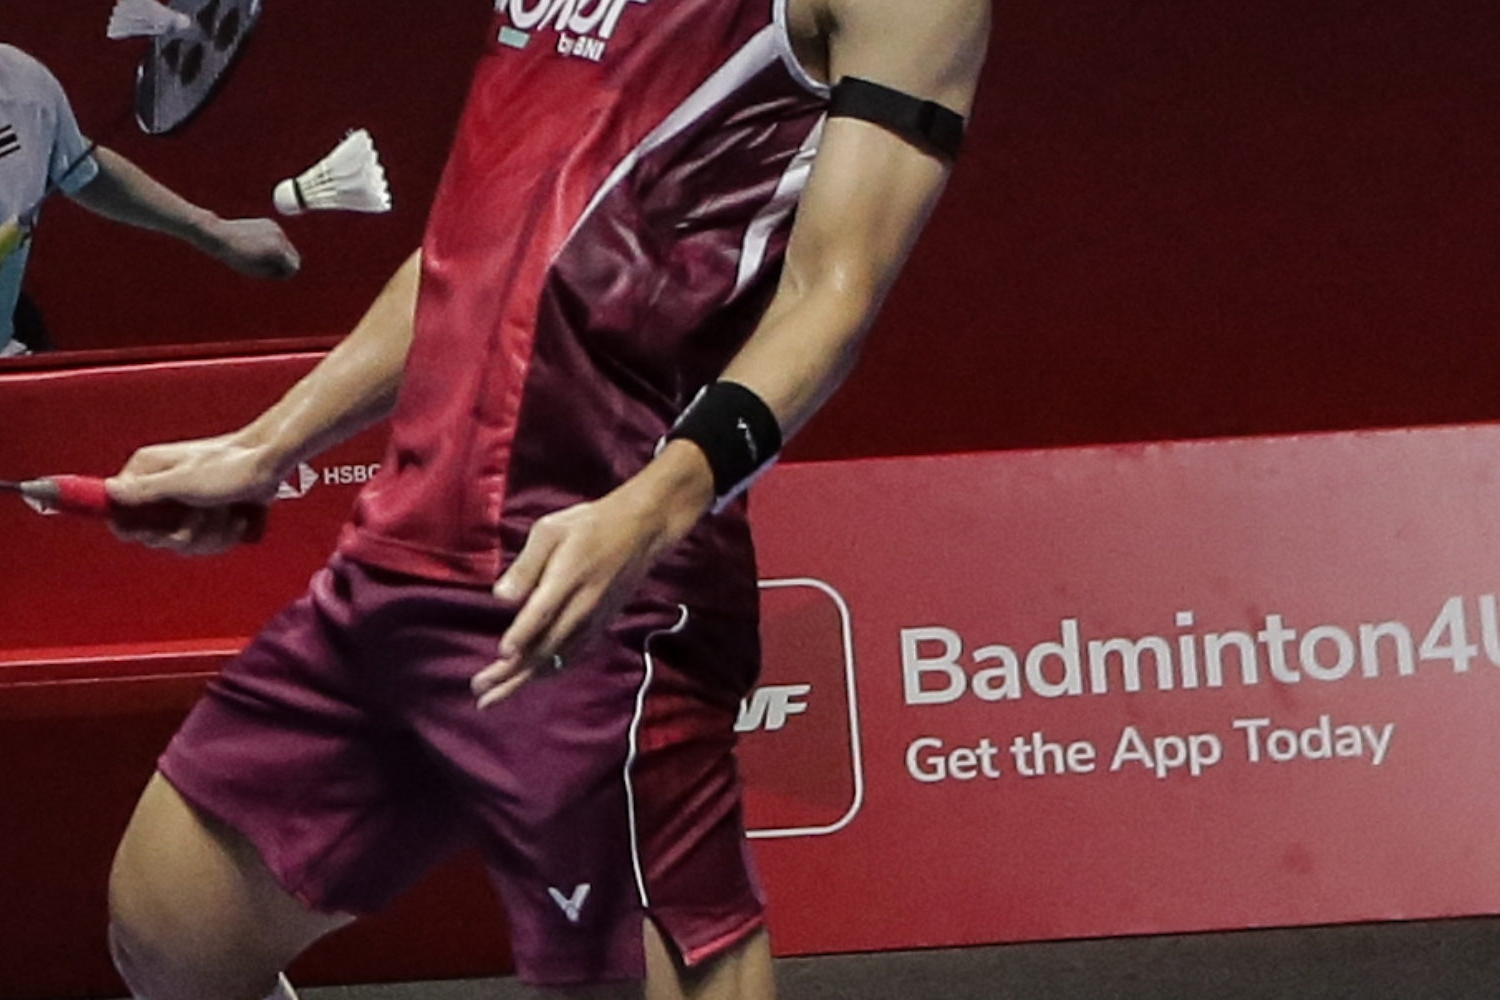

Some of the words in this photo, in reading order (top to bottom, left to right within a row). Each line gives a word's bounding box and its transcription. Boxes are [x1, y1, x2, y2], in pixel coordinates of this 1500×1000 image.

[906, 738, 1000, 782] Get
[1010, 732, 1096, 777] the
[1111, 726, 1222, 777] App
[1233, 715, 1395, 765] Today
